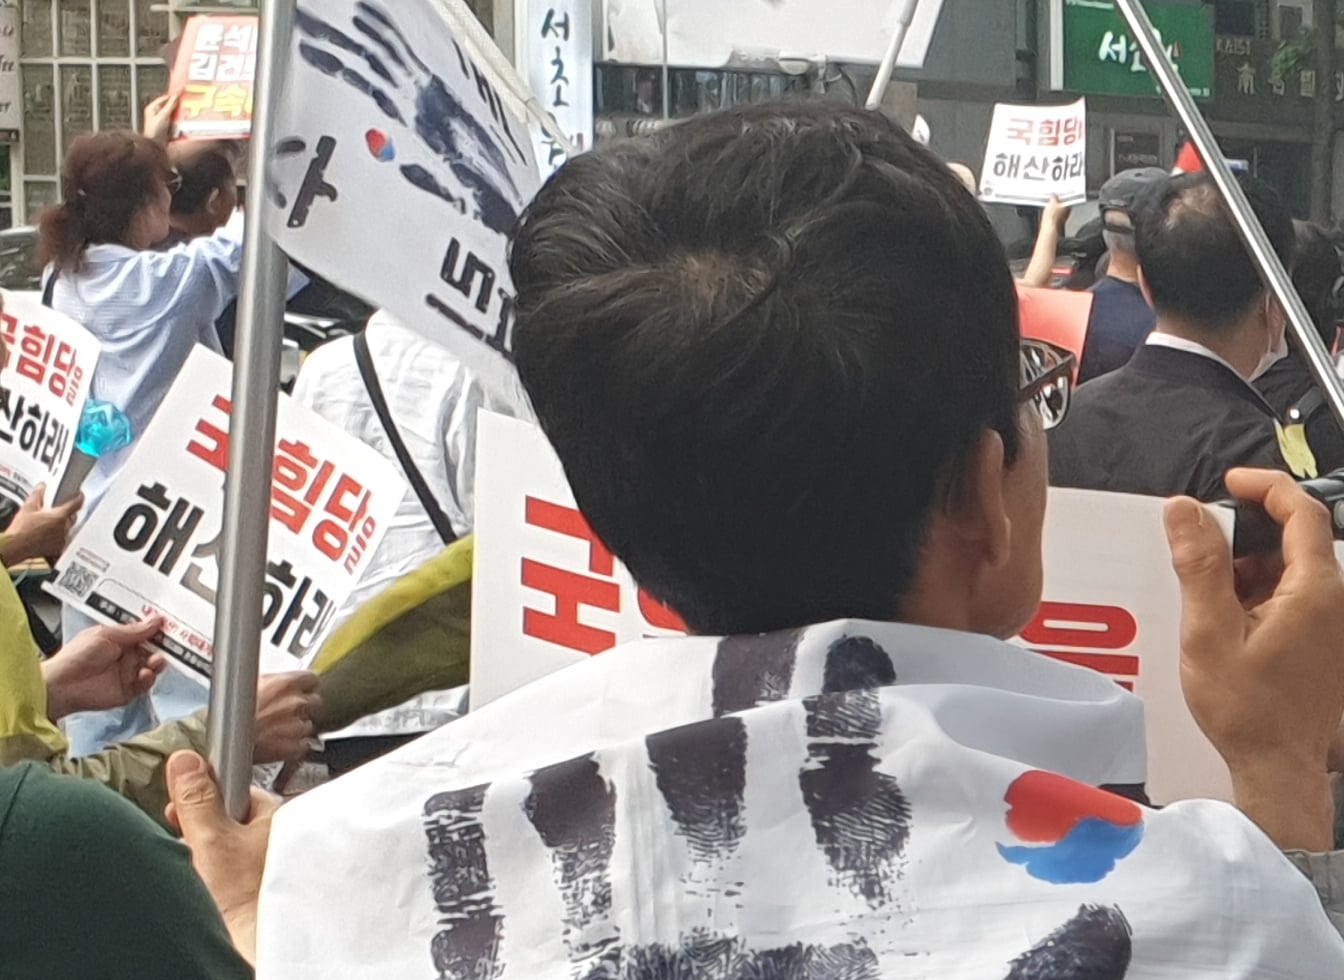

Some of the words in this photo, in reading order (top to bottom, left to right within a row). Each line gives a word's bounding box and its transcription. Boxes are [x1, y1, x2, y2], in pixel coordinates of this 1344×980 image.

[188, 52, 257, 80] 김건
[183, 84, 253, 117] 구속
[1007, 116, 1084, 147] 국힘당
